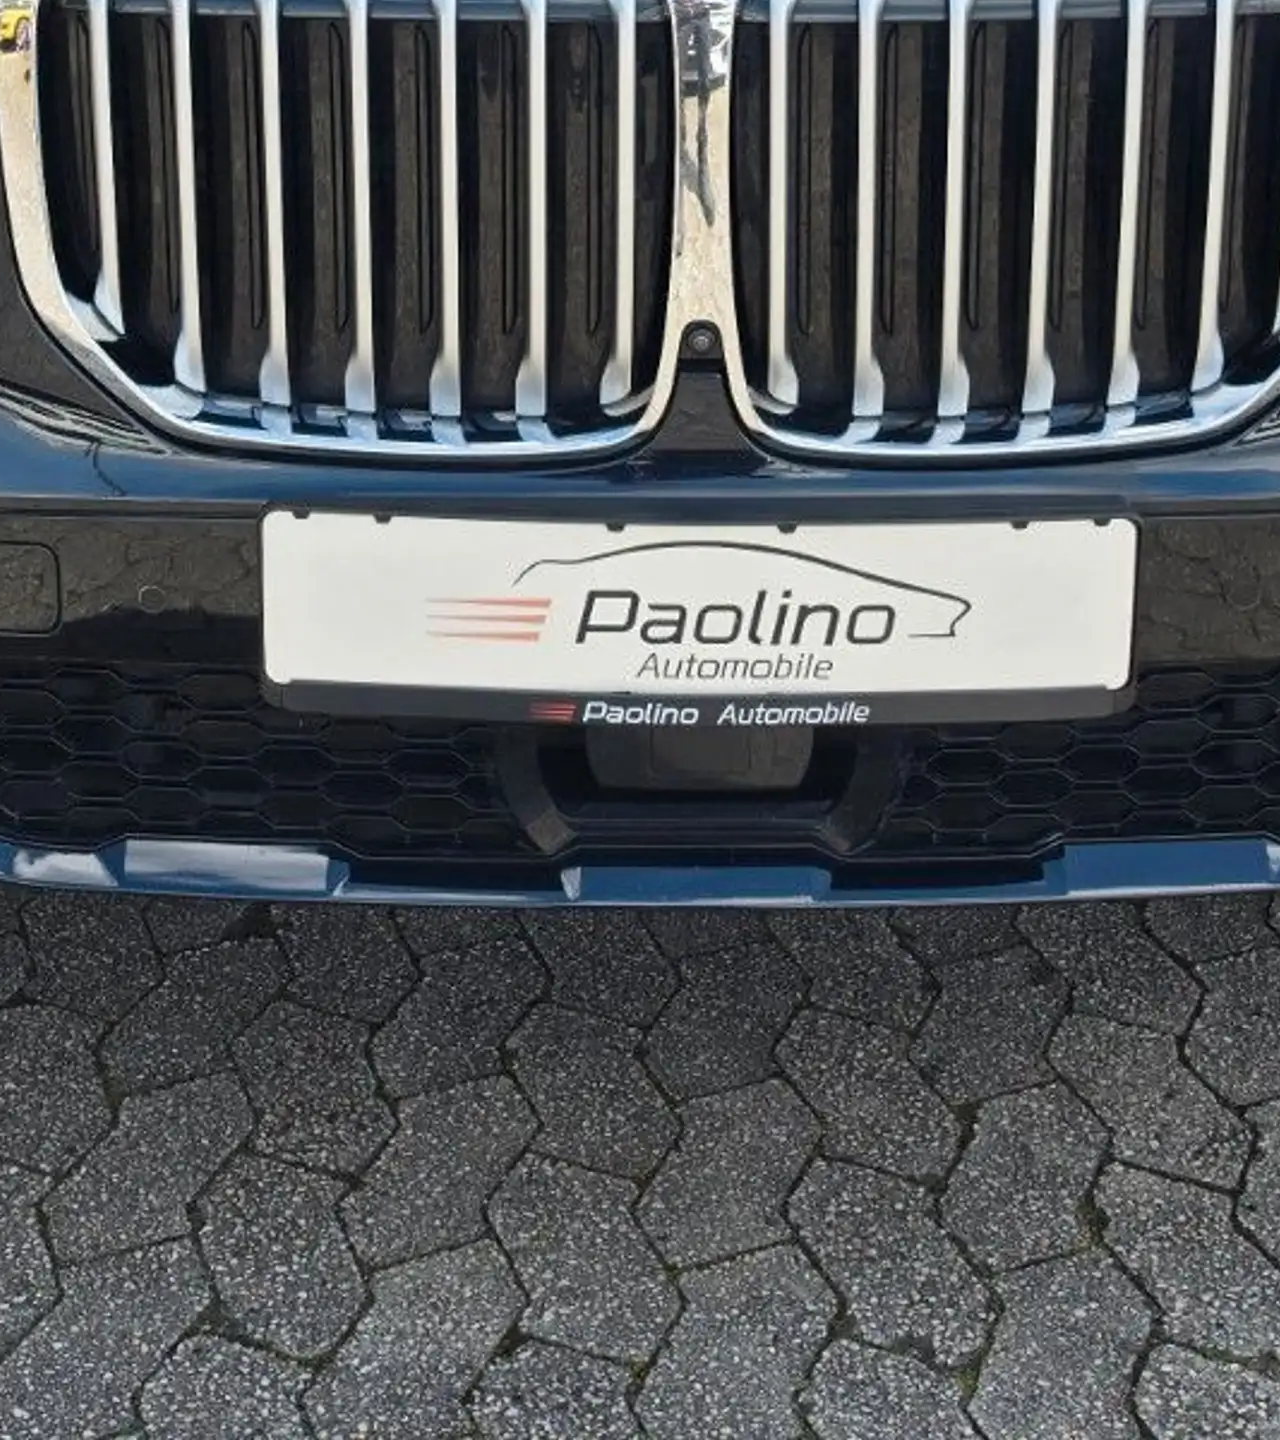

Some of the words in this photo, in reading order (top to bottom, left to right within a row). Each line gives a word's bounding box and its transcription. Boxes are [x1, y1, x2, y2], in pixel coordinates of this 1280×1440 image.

[575, 589, 897, 646] Paolino
[636, 652, 834, 680] Automobile
[582, 700, 700, 726] Paolino
[717, 700, 871, 726] Automobile
